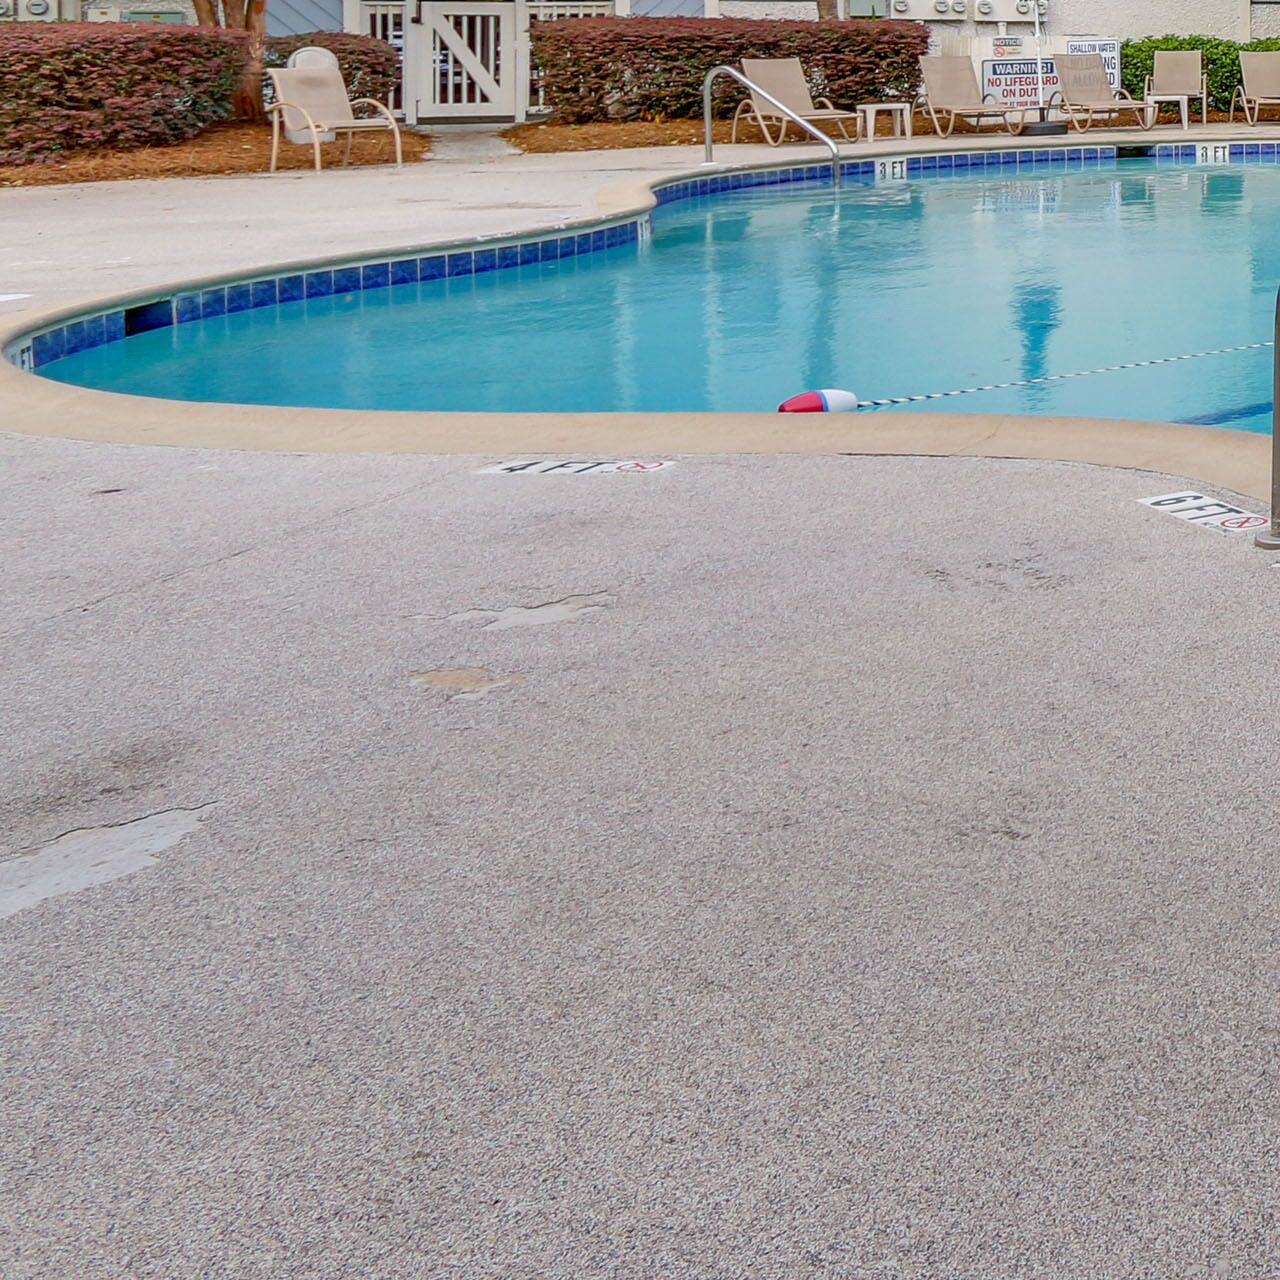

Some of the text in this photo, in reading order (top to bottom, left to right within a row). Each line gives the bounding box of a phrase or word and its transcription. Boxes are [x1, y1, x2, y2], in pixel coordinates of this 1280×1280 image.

[1070, 44, 1096, 53] SHALLOW
[995, 63, 1051, 74] WARNING!
[988, 78, 1001, 87] NO
[1002, 88, 1044, 98] ON DUT
[1214, 145, 1227, 157] FT
[892, 160, 904, 176] FT
[501, 462, 617, 473] 4 FT
[1150, 495, 1243, 520] 6 FT
